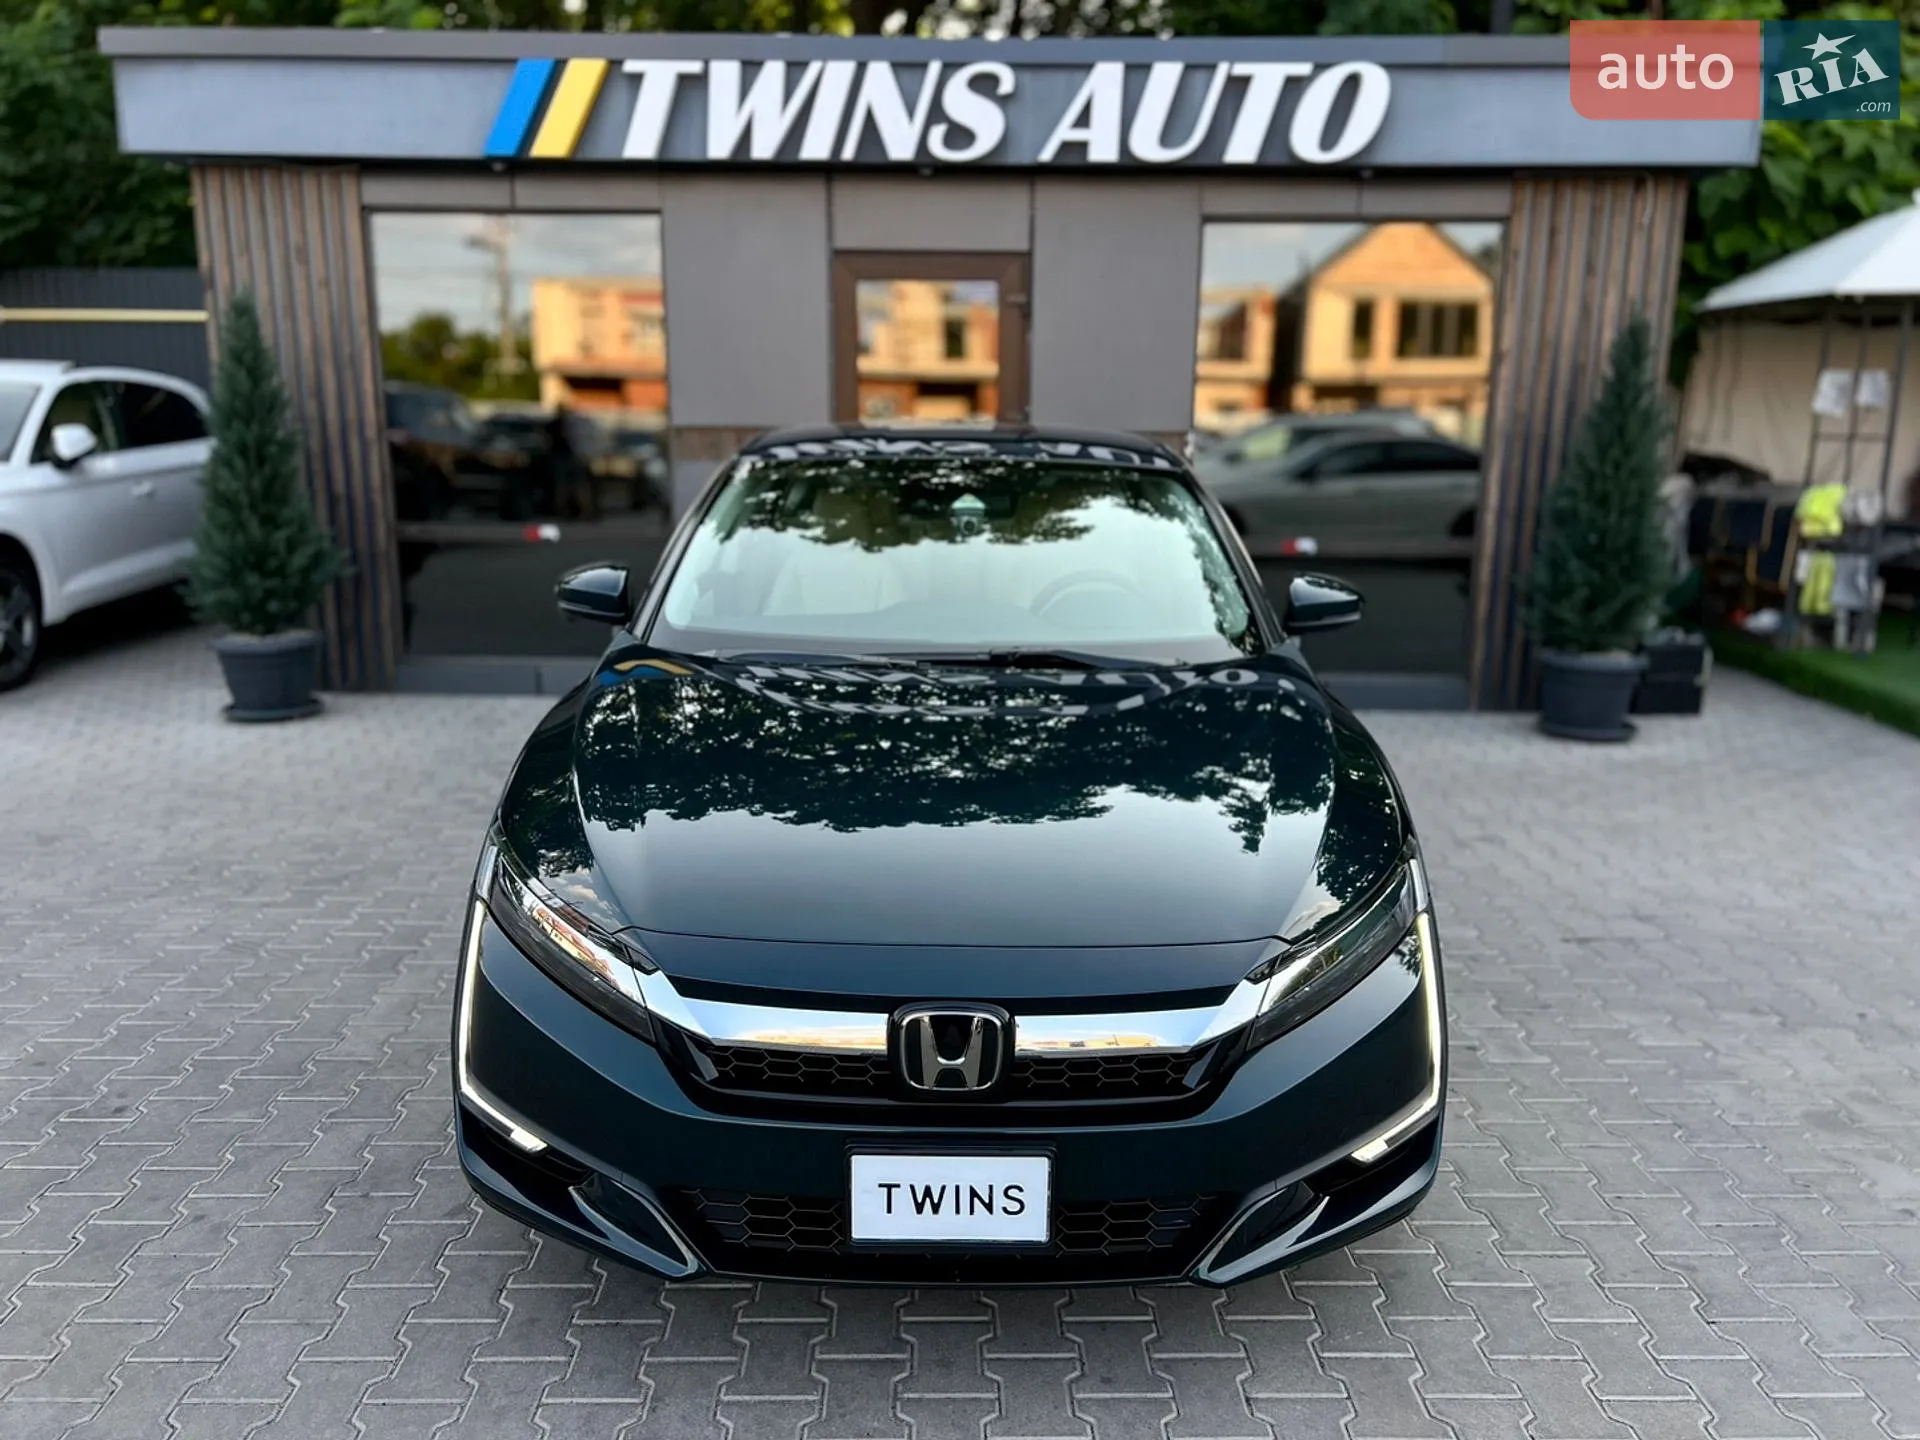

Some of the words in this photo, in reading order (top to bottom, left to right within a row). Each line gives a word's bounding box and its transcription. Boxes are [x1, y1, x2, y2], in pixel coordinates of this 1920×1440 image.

[621, 59, 1017, 162] TWINS
[1037, 61, 1392, 164] AUTO
[878, 1183, 1026, 1216] TWINS
